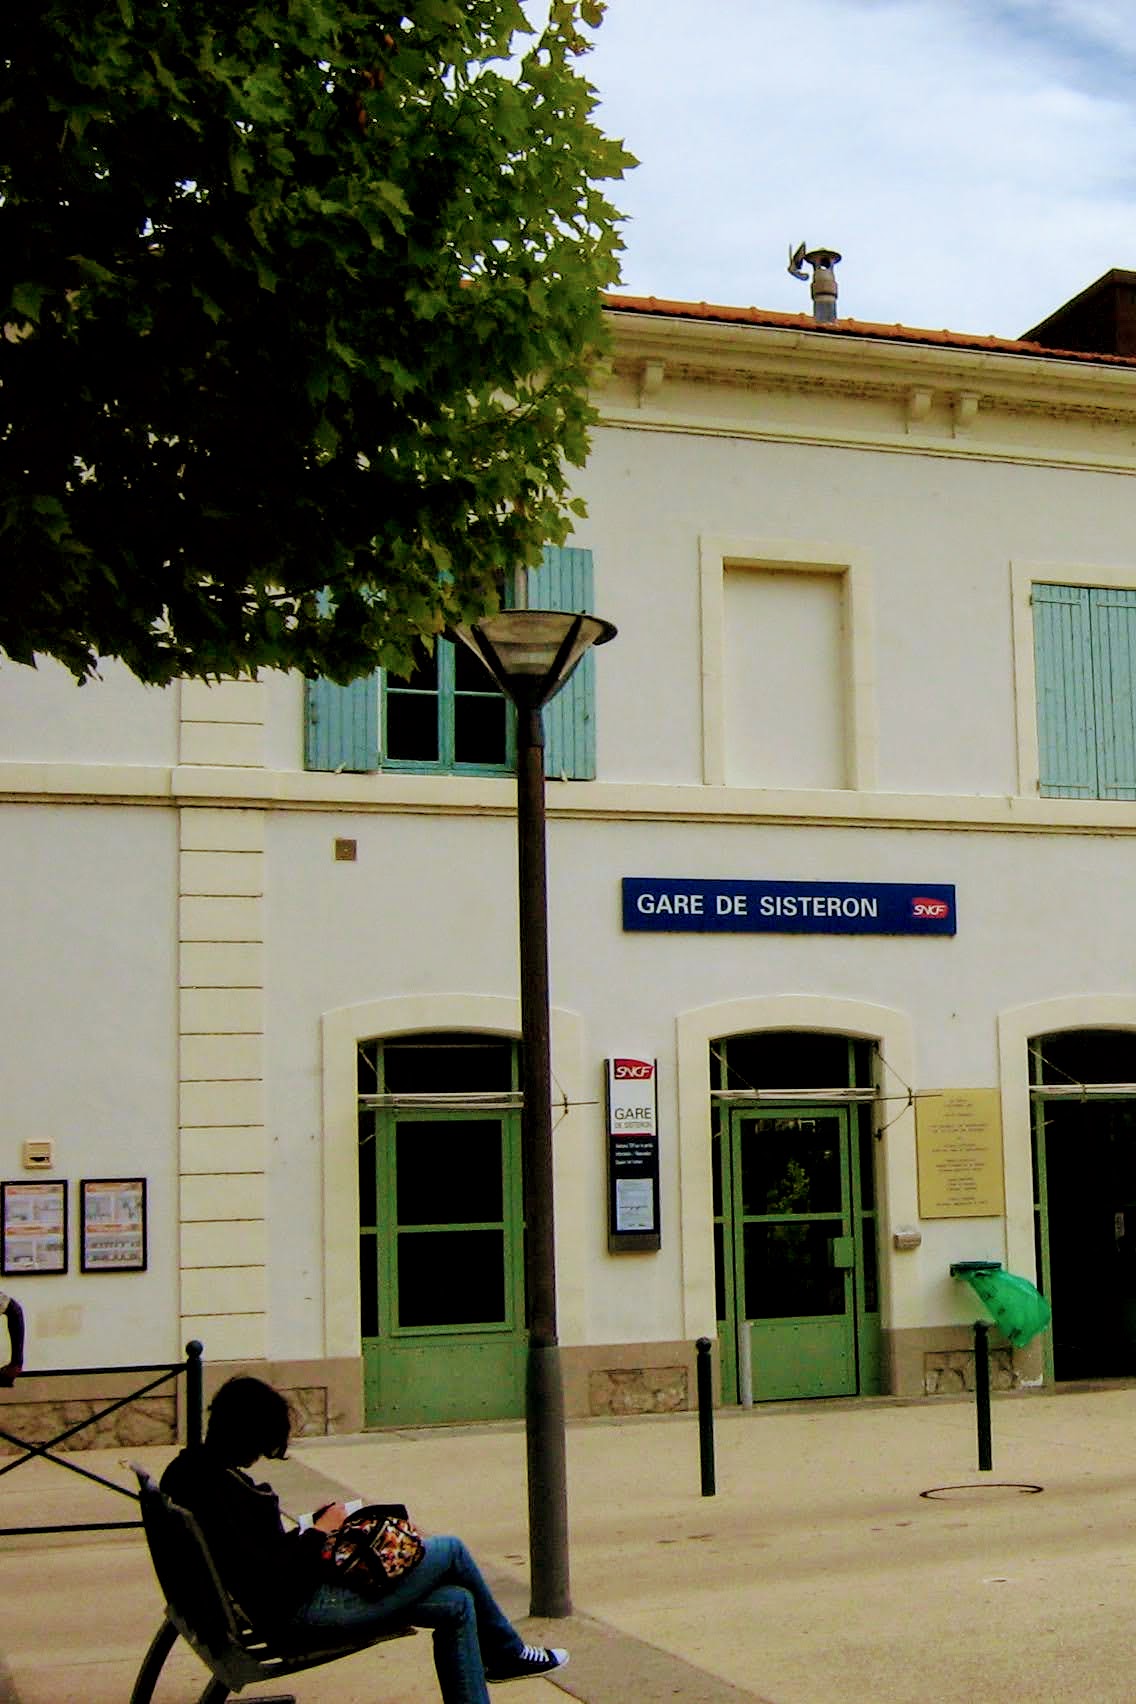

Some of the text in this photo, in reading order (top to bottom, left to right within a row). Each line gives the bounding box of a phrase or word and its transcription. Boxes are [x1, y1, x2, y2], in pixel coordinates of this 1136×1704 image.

[637, 894, 877, 917] GARE DE SISTERON
[913, 904, 946, 918] SNCF
[615, 1066, 651, 1078] SNCF
[614, 1107, 652, 1120] GARE
